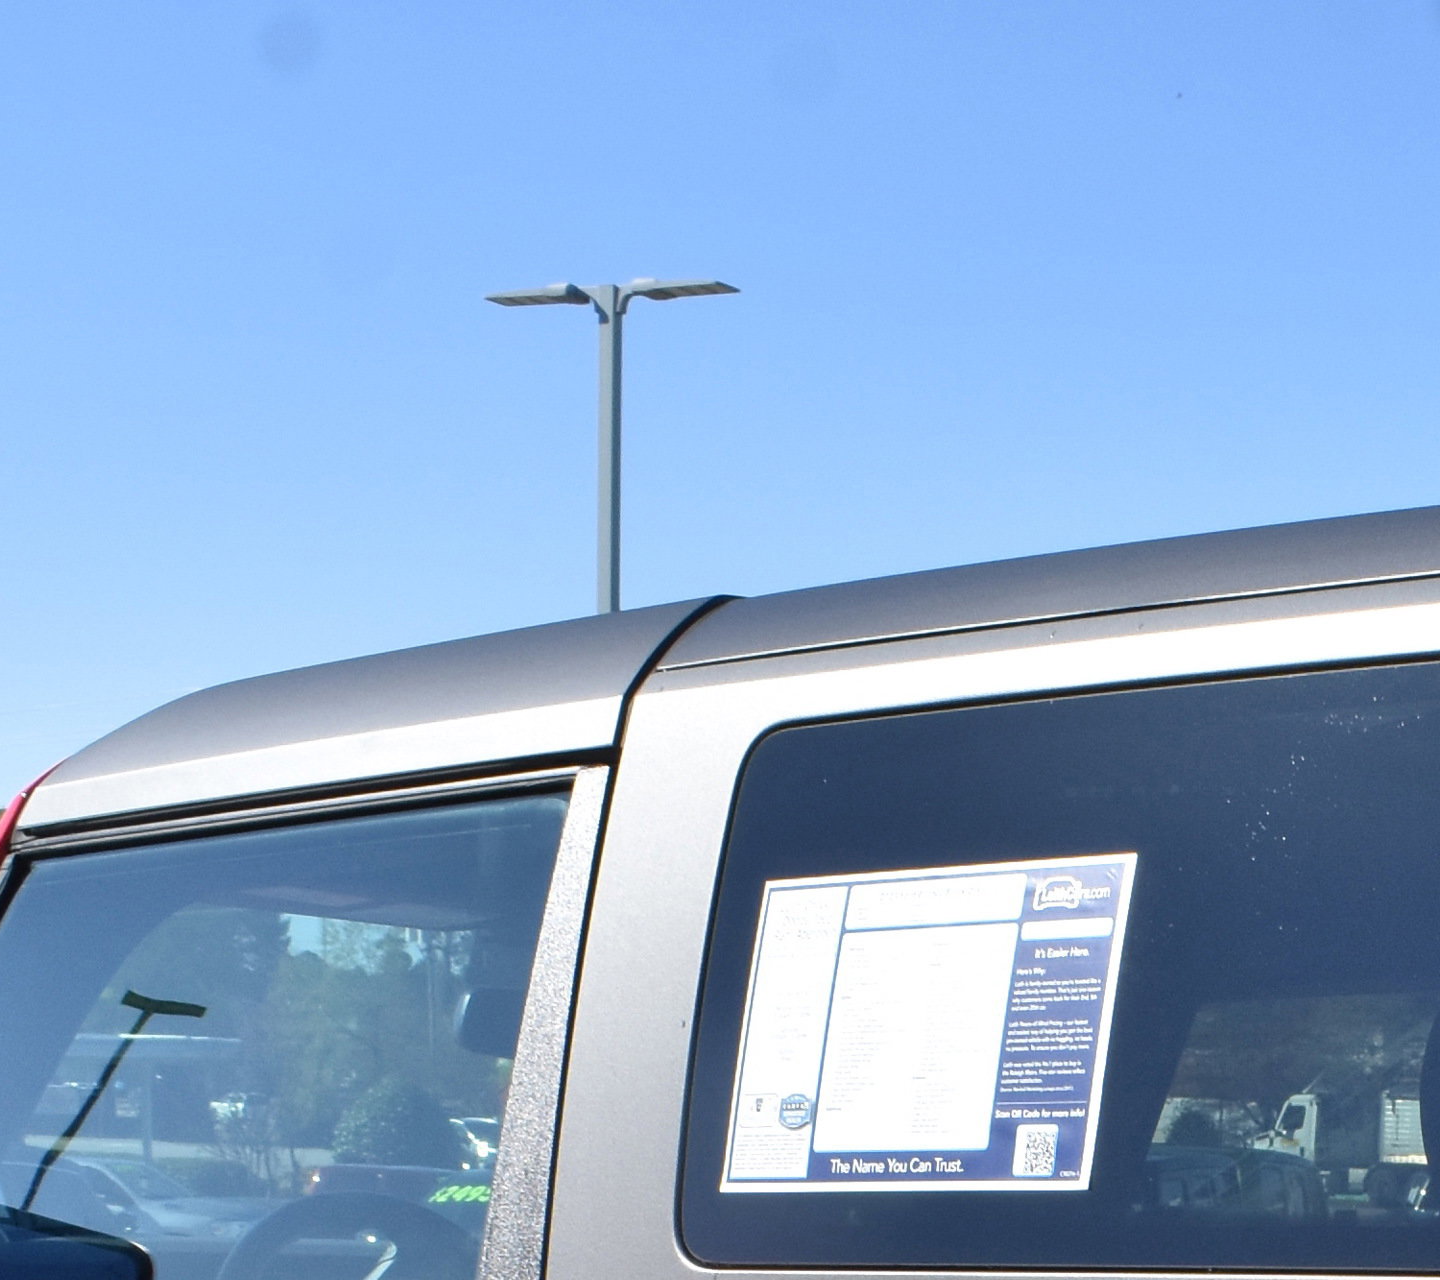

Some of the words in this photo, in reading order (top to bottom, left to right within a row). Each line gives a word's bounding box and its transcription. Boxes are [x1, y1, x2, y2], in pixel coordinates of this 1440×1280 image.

[830, 1159, 851, 1175] The
[852, 1158, 885, 1175] Name
[887, 1158, 907, 1174] You
[909, 1157, 932, 1173] Can
[934, 1156, 964, 1173] Trust.
